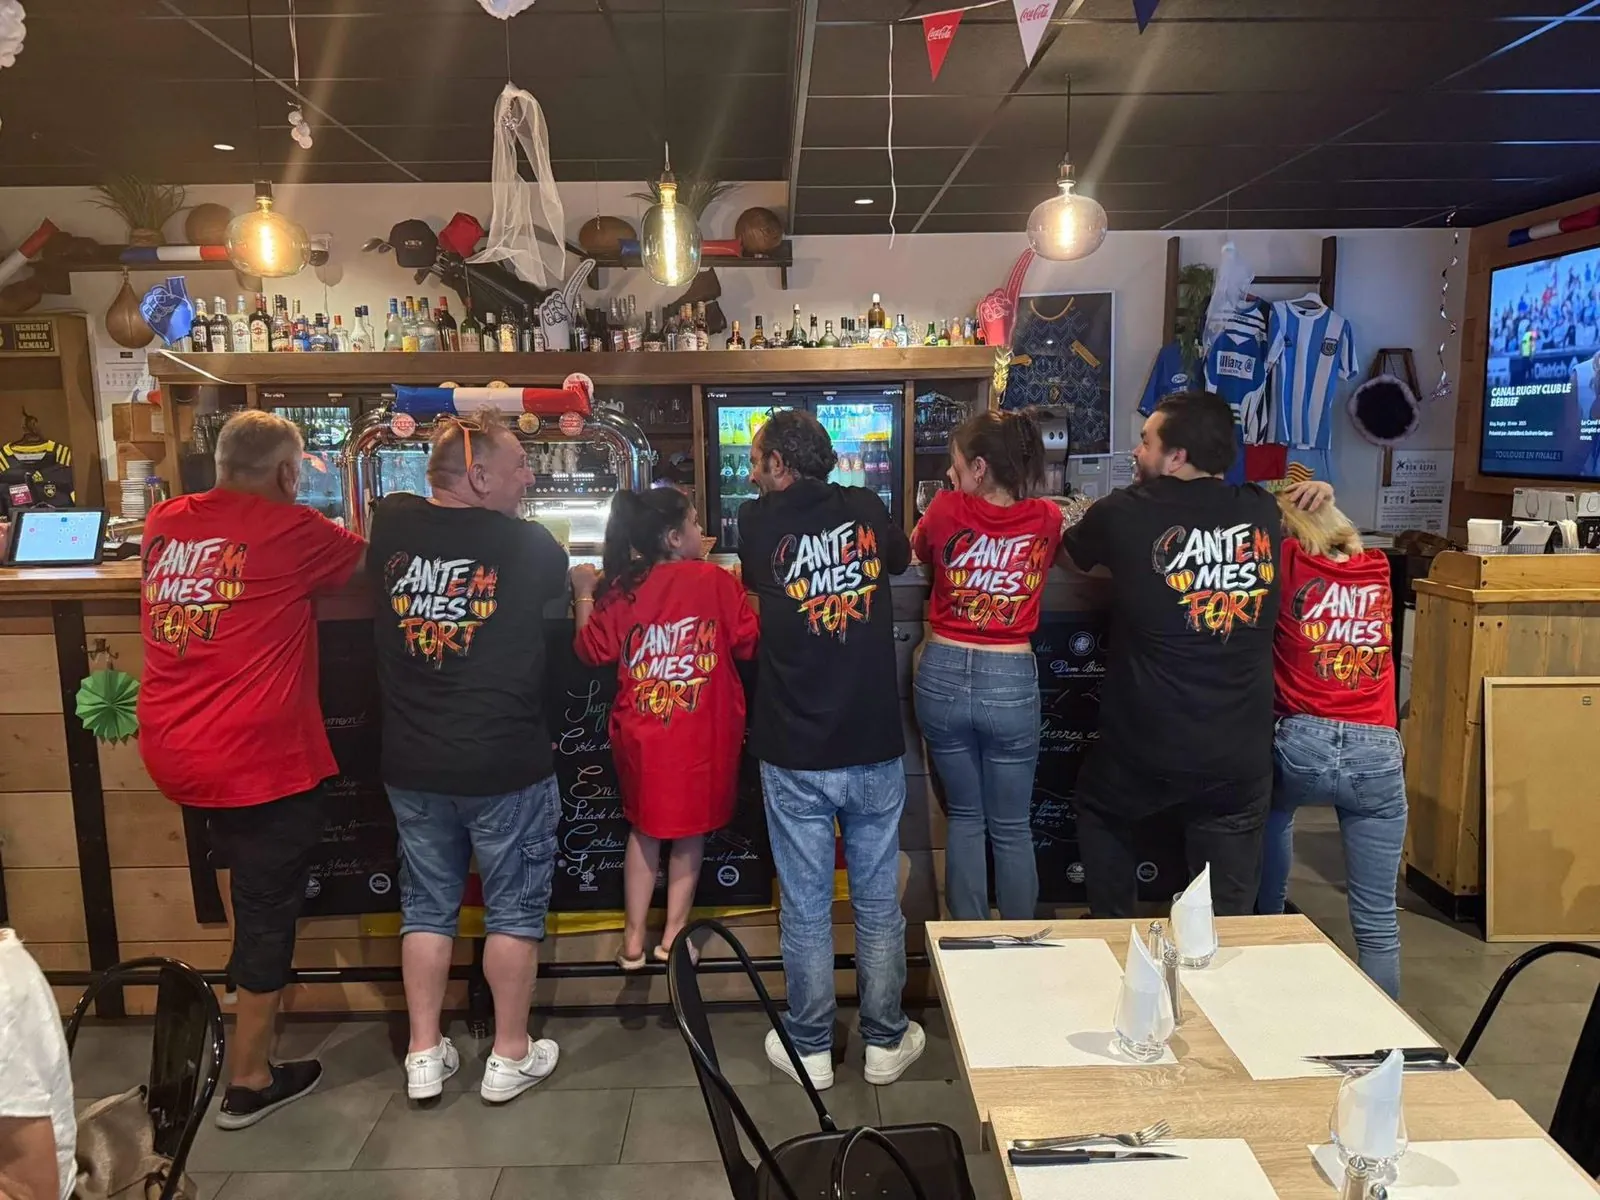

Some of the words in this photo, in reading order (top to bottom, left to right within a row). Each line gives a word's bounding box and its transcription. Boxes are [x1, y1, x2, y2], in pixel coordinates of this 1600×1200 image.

[1491, 387, 1516, 397] CANAL
[1516, 385, 1542, 396] RUGBY
[1542, 384, 1562, 395] CLUB
[1562, 383, 1572, 393] LE
[144, 535, 247, 582] CANTEM
[771, 520, 878, 585] CANTEM
[943, 528, 1049, 570] CANTEM
[1152, 523, 1273, 576] CANTEM
[158, 577, 214, 603] MES
[384, 550, 499, 598] CANTEM
[809, 561, 862, 597] MES
[966, 568, 1024, 593] MES
[1194, 562, 1257, 590] MES
[149, 602, 232, 656] FORT
[409, 594, 468, 621] MES
[797, 584, 878, 644] FORT
[950, 589, 1031, 632] FORT
[1177, 588, 1269, 645] FORT
[398, 617, 487, 670] FORT
[622, 615, 718, 668] CANTEM
[1326, 618, 1383, 645] MES
[646, 654, 695, 679] MES
[1309, 642, 1390, 690] FORT
[633, 676, 711, 727] FORT
